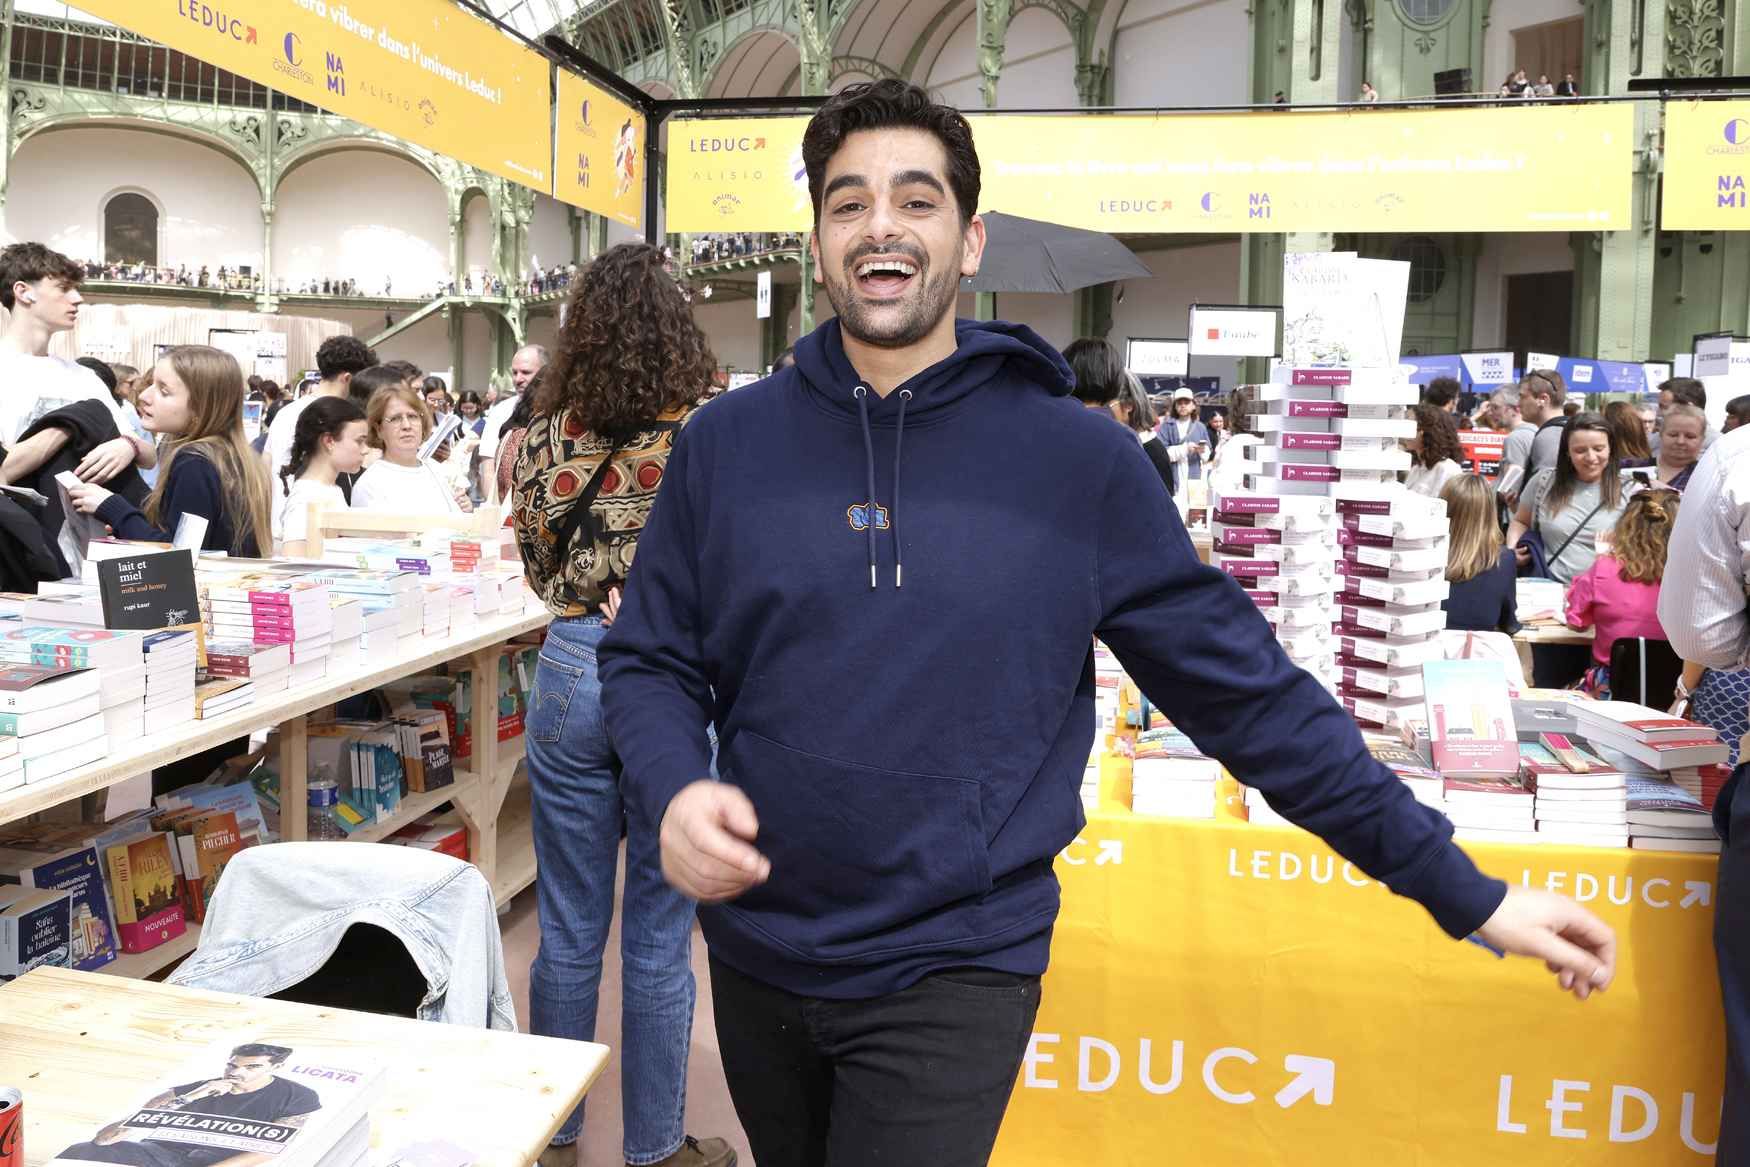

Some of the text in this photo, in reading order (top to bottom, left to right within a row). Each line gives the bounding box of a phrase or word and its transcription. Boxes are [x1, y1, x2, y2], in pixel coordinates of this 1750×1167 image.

[178, 0, 242, 41] LEDUC
[330, 6, 375, 41] vibrer
[378, 28, 410, 60] dans
[465, 72, 496, 102] Leduc
[326, 51, 344, 74] NA
[326, 74, 345, 97] MI
[690, 138, 750, 152] LEDUC
[578, 153, 590, 169] NA
[577, 172, 590, 188] MI
[1717, 175, 1745, 191] NA
[1099, 200, 1157, 213] LEDUC
[1249, 192, 1271, 206] NA
[1717, 192, 1746, 208] MI
[1249, 206, 1271, 219] MI
[1481, 357, 1500, 367] MER
[118, 561, 147, 572] lait et
[119, 571, 142, 582] miel
[121, 583, 167, 594] milk and honey
[124, 604, 136, 612] rupi
[1229, 848, 1369, 887] LEDUC
[291, 1066, 359, 1084] LICATA
[1024, 1033, 1259, 1104] EDUC
[1497, 1074, 1724, 1155] LEDU
[132, 1112, 288, 1142] RÉVÉLATION(S)
